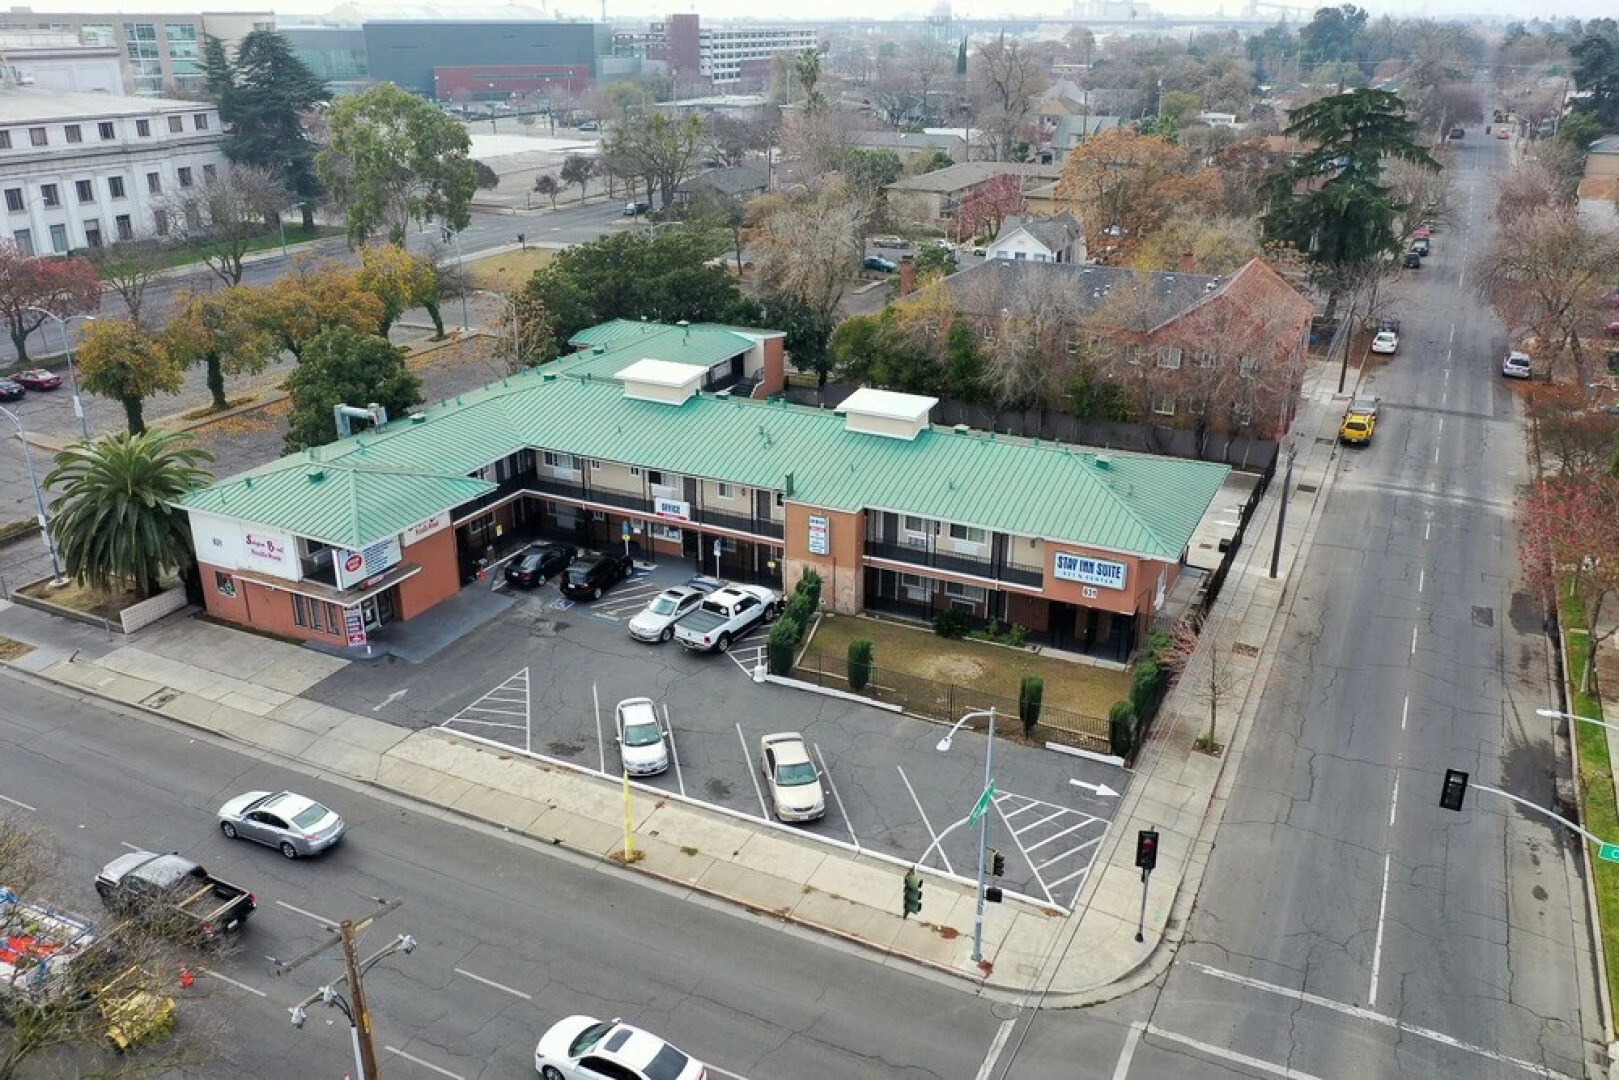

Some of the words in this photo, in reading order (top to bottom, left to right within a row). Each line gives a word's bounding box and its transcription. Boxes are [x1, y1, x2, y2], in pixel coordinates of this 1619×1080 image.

[662, 502, 680, 514] OFFICE
[1058, 556, 1078, 570] STAY
[1080, 560, 1094, 574] INN
[1096, 563, 1121, 578] SUITE
